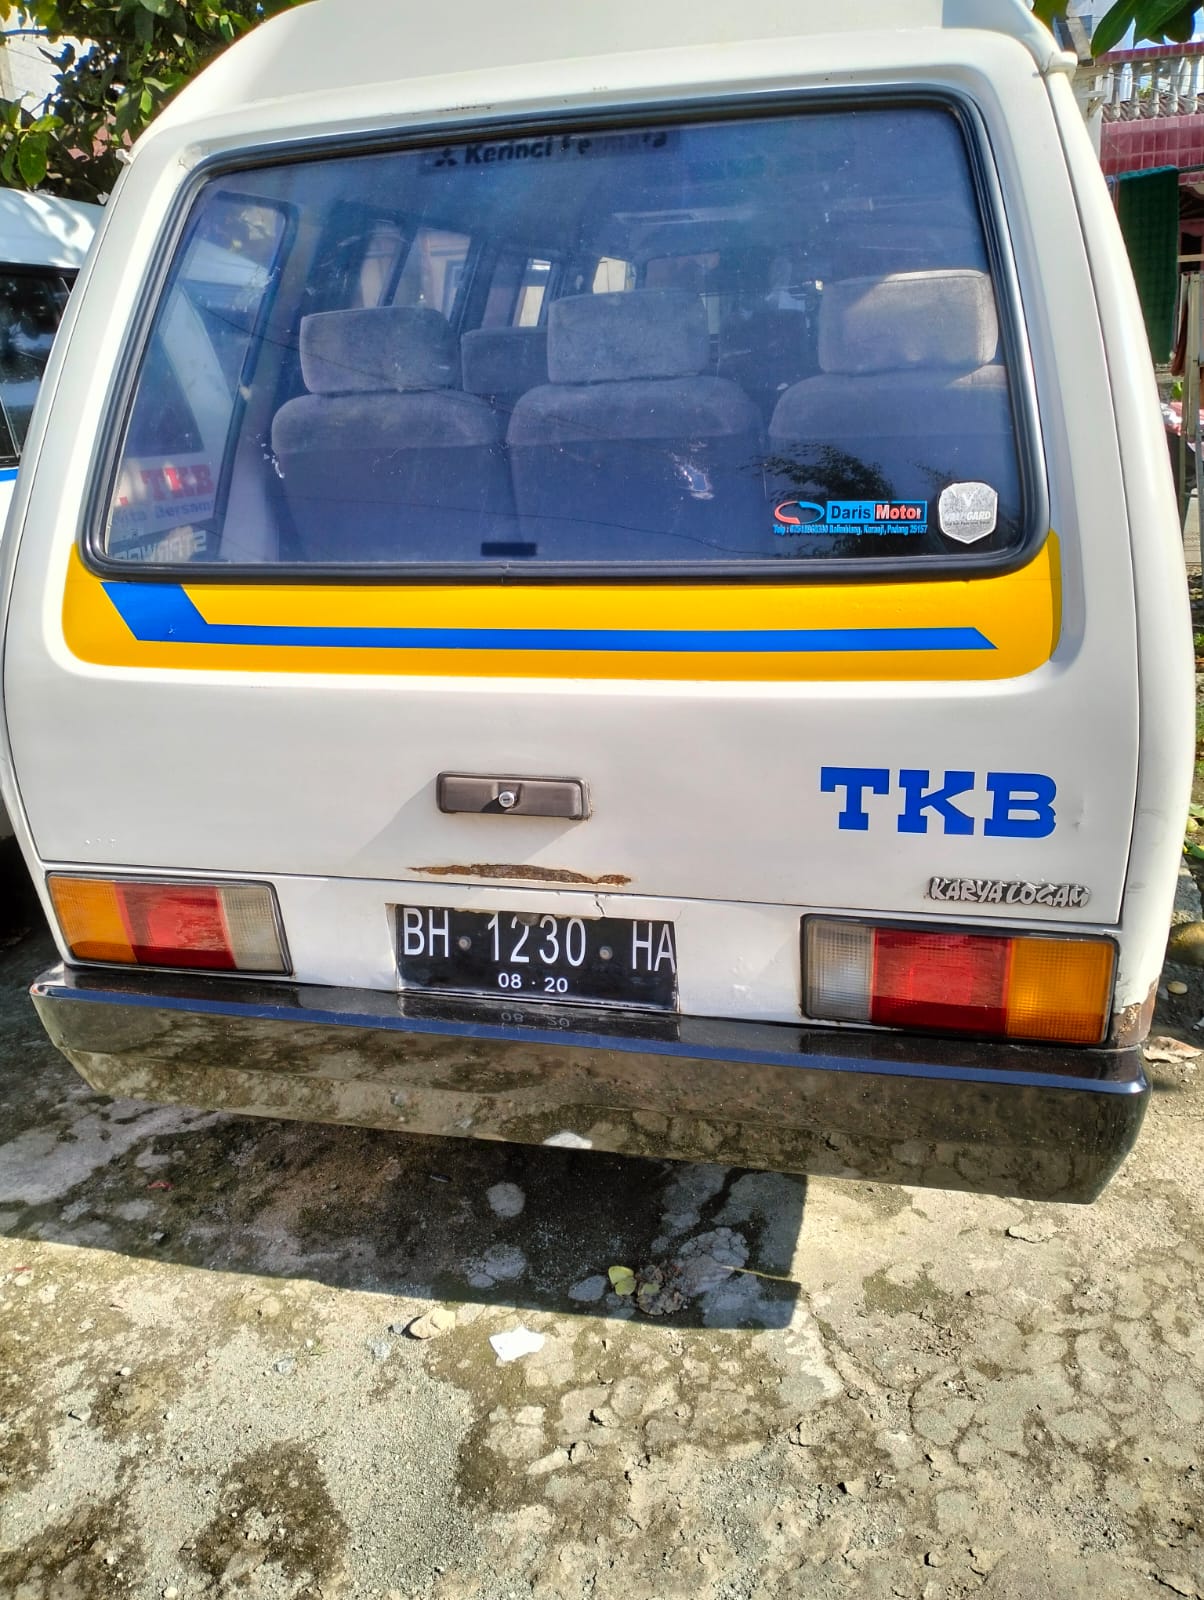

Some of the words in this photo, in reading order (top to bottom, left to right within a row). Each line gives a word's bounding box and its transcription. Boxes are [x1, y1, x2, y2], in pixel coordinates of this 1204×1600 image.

[831, 505, 871, 520] Daris
[876, 504, 922, 520] Motor
[820, 766, 1057, 839] TKB
[929, 876, 1003, 904] KARYA
[1004, 881, 1091, 908] LOGAM
[403, 907, 449, 958] BH
[487, 910, 586, 967] 1230
[632, 920, 677, 973] HA
[498, 972, 522, 989] 08
[544, 977, 568, 993] 20
